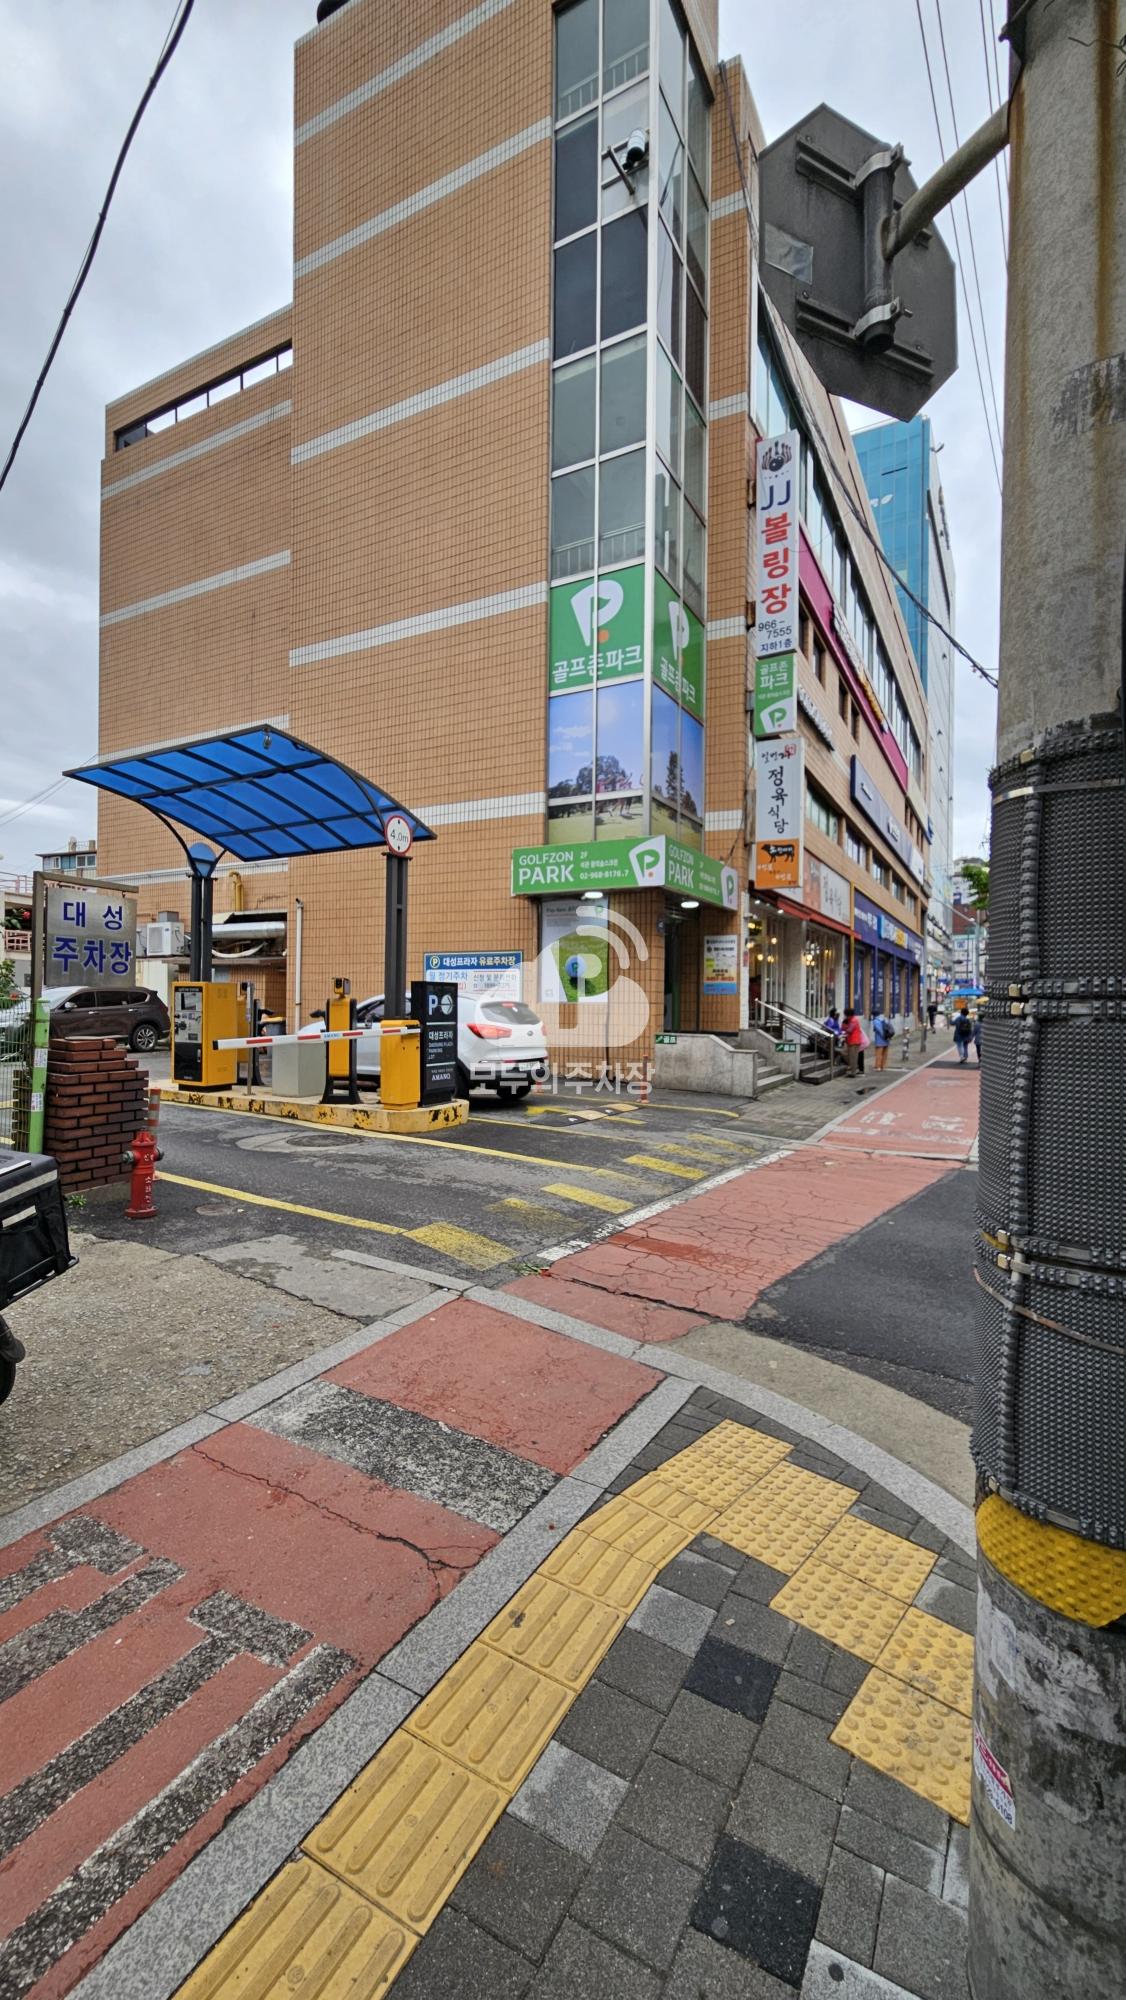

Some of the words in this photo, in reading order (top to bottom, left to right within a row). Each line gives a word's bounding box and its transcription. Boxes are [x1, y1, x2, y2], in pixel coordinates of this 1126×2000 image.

[760, 480, 791, 511] JJ
[761, 512, 792, 615] 볼링장
[766, 626, 793, 639] 7555
[552, 645, 643, 684] 골프존파크
[760, 661, 789, 675] 골프존
[760, 672, 789, 690] 파크
[767, 765, 789, 834] 정육식당
[519, 851, 574, 866] GOLFZON
[668, 844, 694, 867] GOLFZON
[518, 864, 575, 886] PARK
[668, 860, 694, 889] PARK
[52, 936, 132, 974] 주차장
[442, 956, 478, 967] 대성프라자
[479, 955, 516, 966] 유료주차장
[428, 994, 438, 1015] P
[428, 1030, 454, 1041] 대성프라자
[431, 1072, 452, 1081] AMANO
